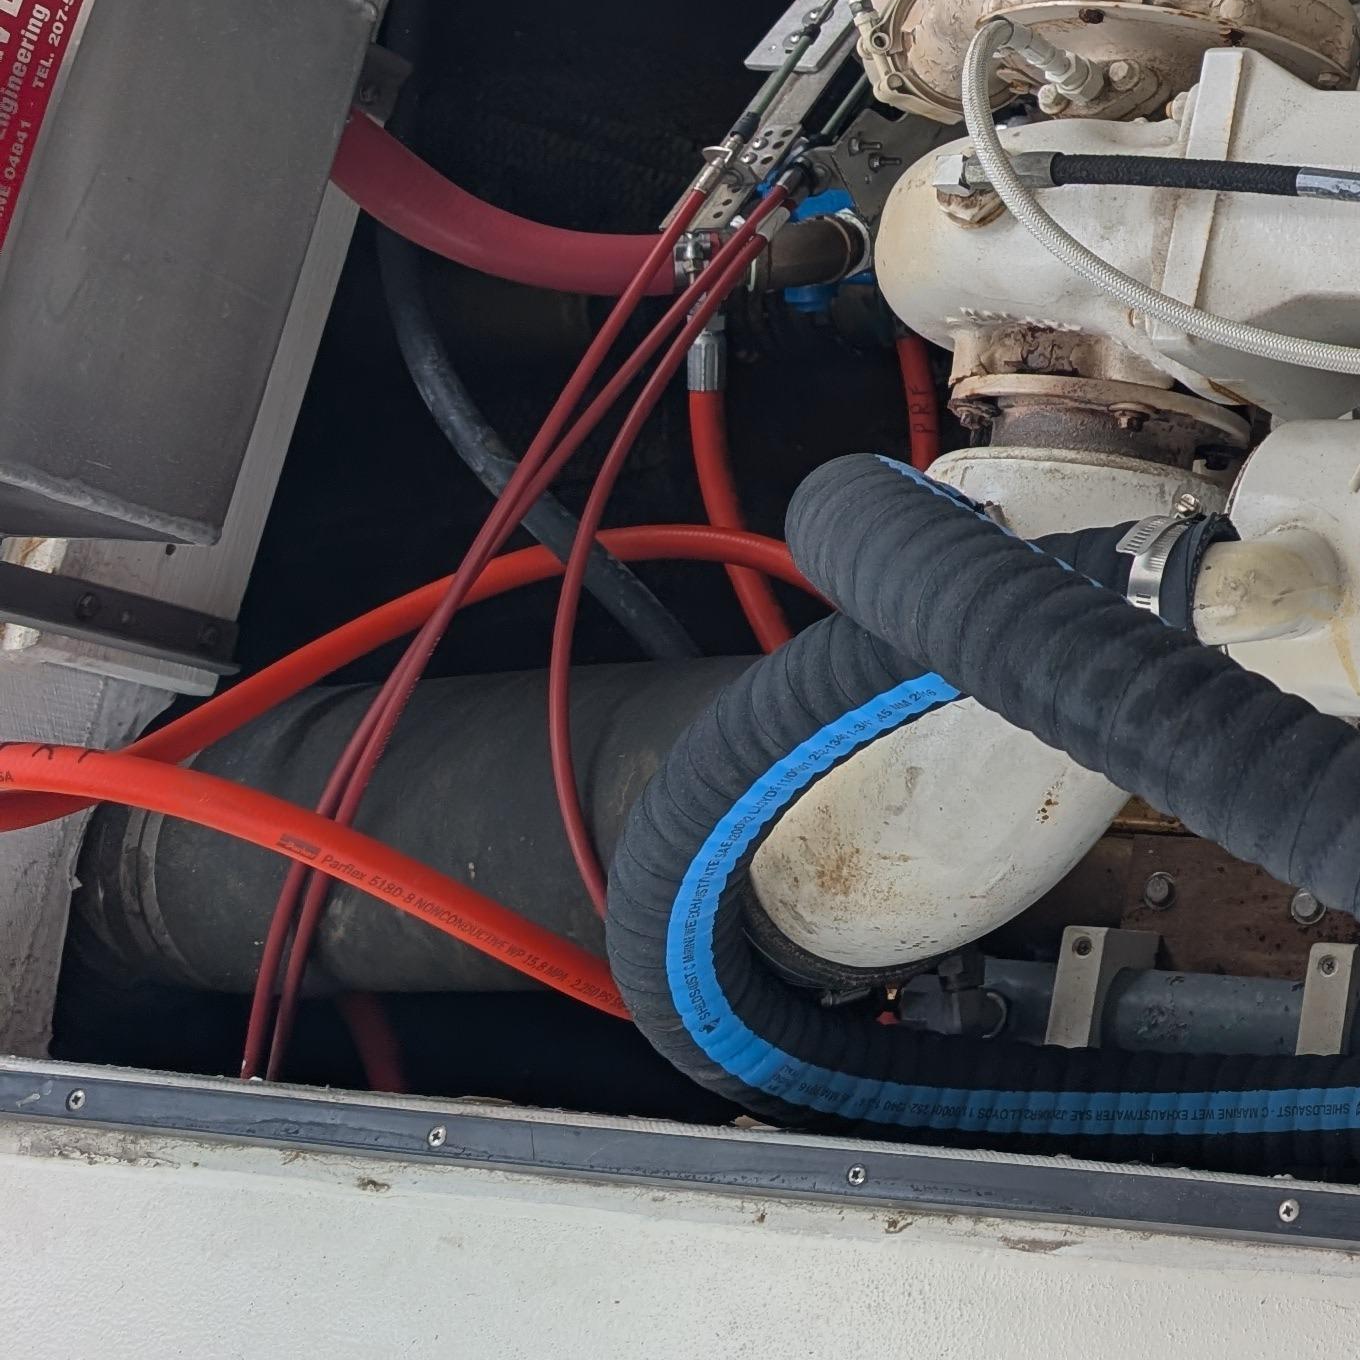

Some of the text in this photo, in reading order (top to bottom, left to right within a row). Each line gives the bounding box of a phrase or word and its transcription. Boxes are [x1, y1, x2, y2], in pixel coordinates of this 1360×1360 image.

[0, 3, 51, 139] ngineering
[1190, 1109, 1215, 1121] WET
[1218, 1107, 1259, 1120] MARINE
